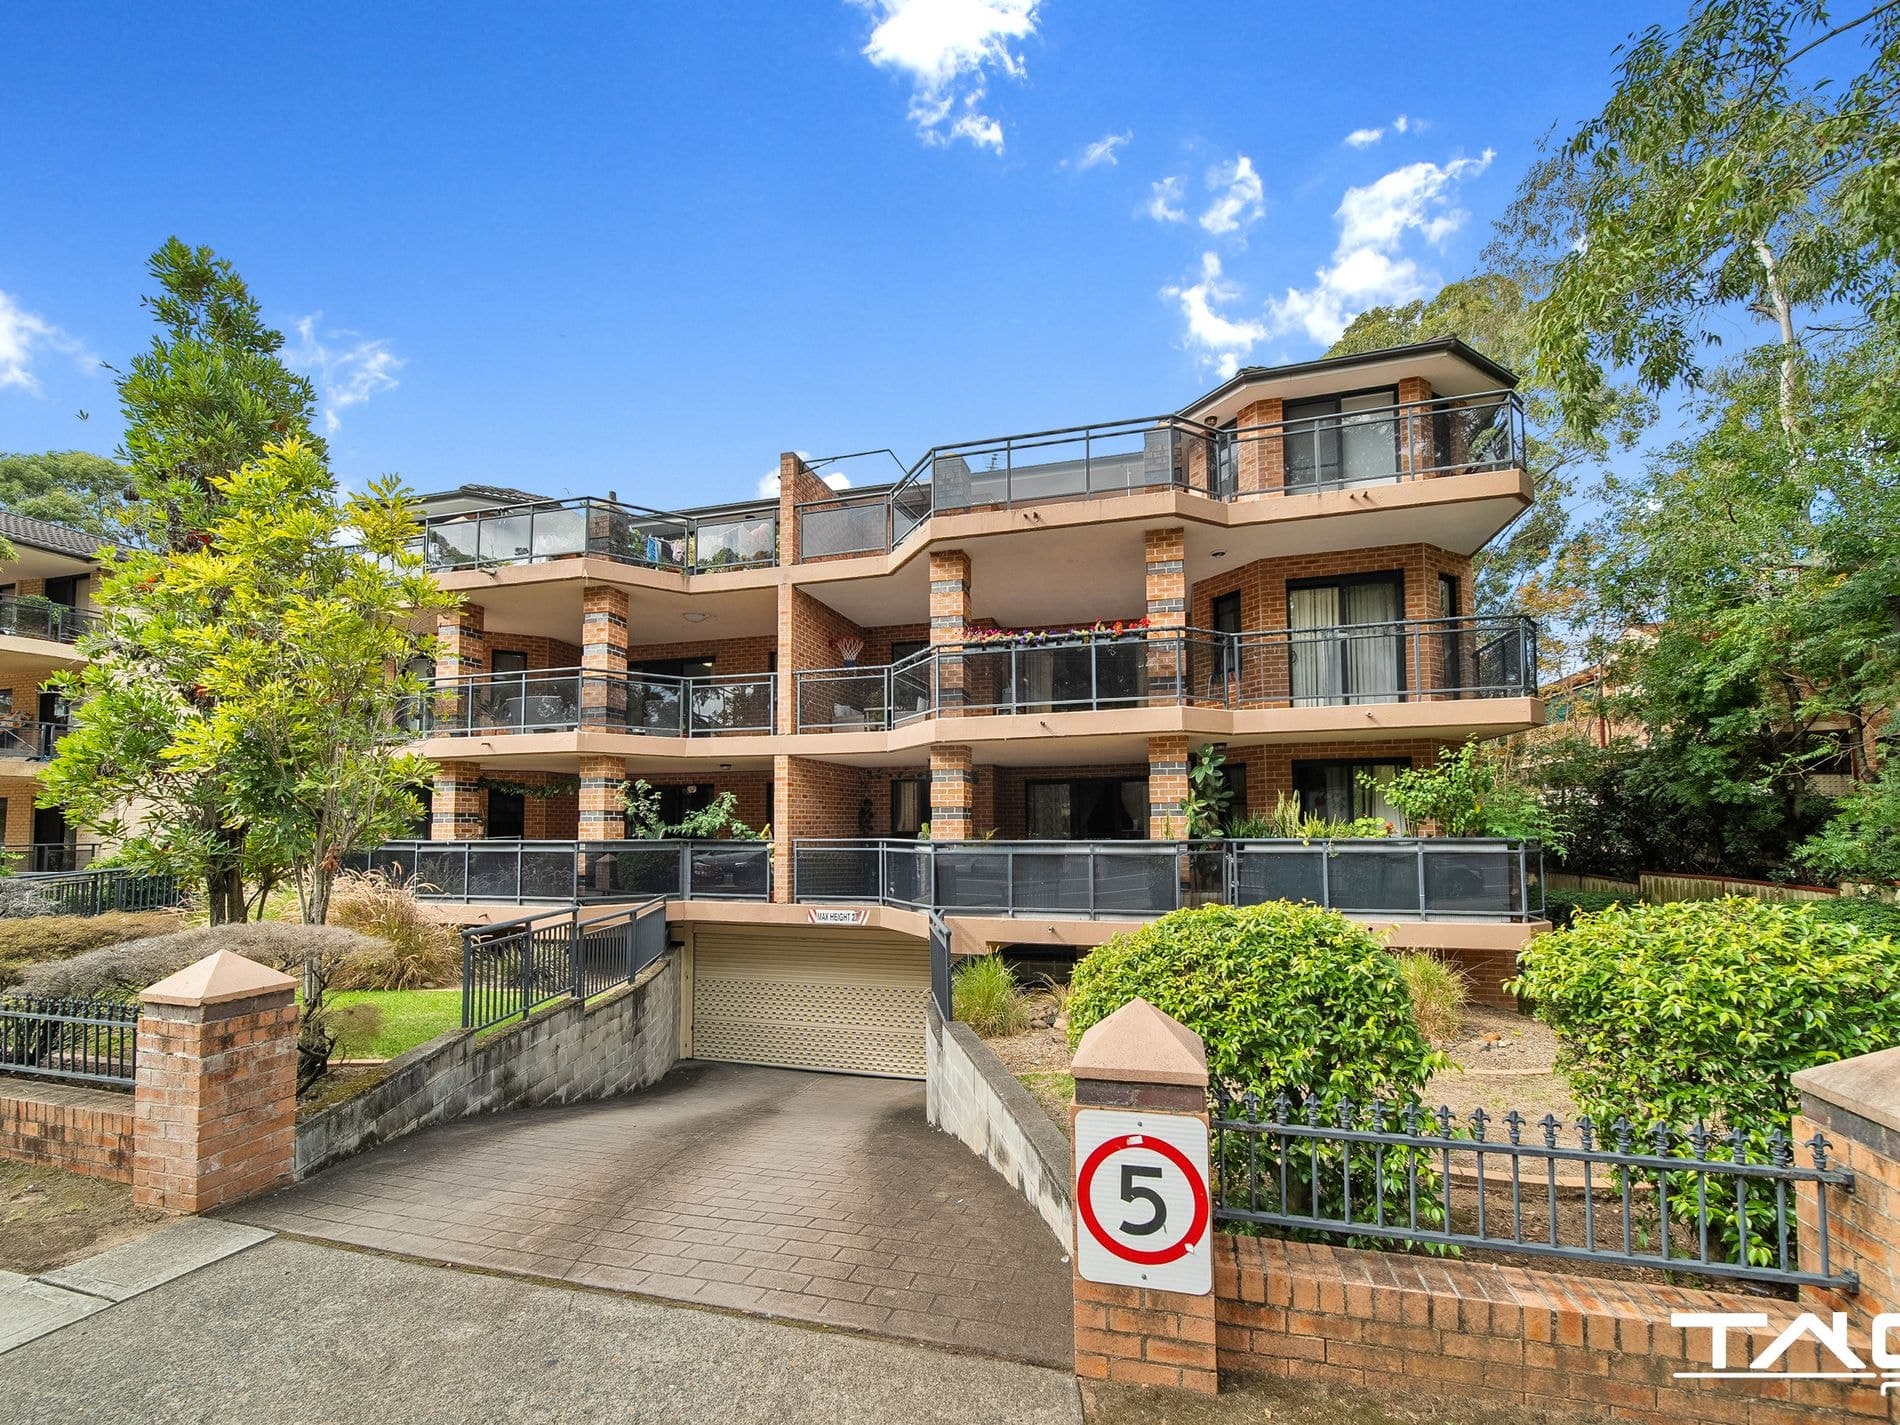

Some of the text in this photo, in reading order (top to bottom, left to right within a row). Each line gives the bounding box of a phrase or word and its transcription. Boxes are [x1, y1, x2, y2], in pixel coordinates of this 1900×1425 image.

[817, 912, 829, 921] MAX
[830, 912, 850, 922] HEIGHT
[1119, 1164, 1167, 1236] 5
